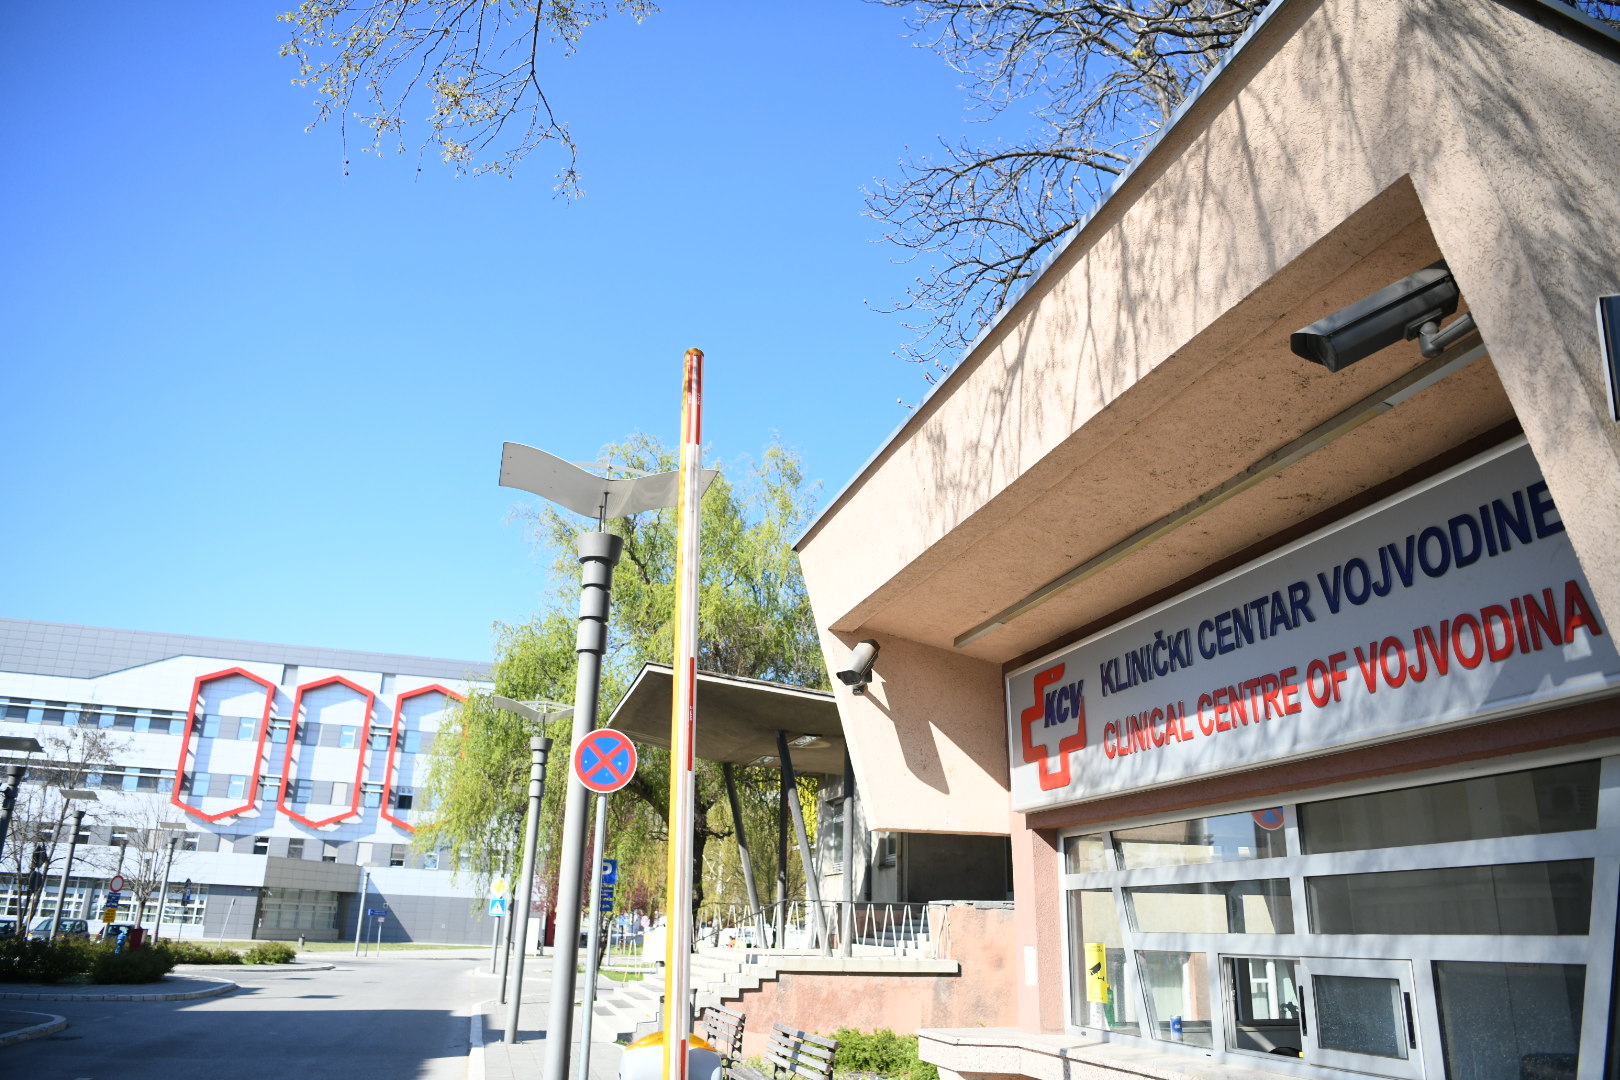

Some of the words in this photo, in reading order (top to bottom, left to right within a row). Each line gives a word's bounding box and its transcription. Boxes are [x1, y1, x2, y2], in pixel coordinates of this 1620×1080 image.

[1100, 629, 1194, 698] KLINIČKI
[1197, 582, 1316, 660] CENTAR
[1317, 480, 1566, 615] VOJVODINE
[1103, 701, 1194, 759] CLINICAL
[1197, 666, 1302, 736] CENTRE
[1306, 651, 1348, 707] OF
[1353, 579, 1603, 694] VOJVODINA
[1044, 679, 1085, 728] KCV
